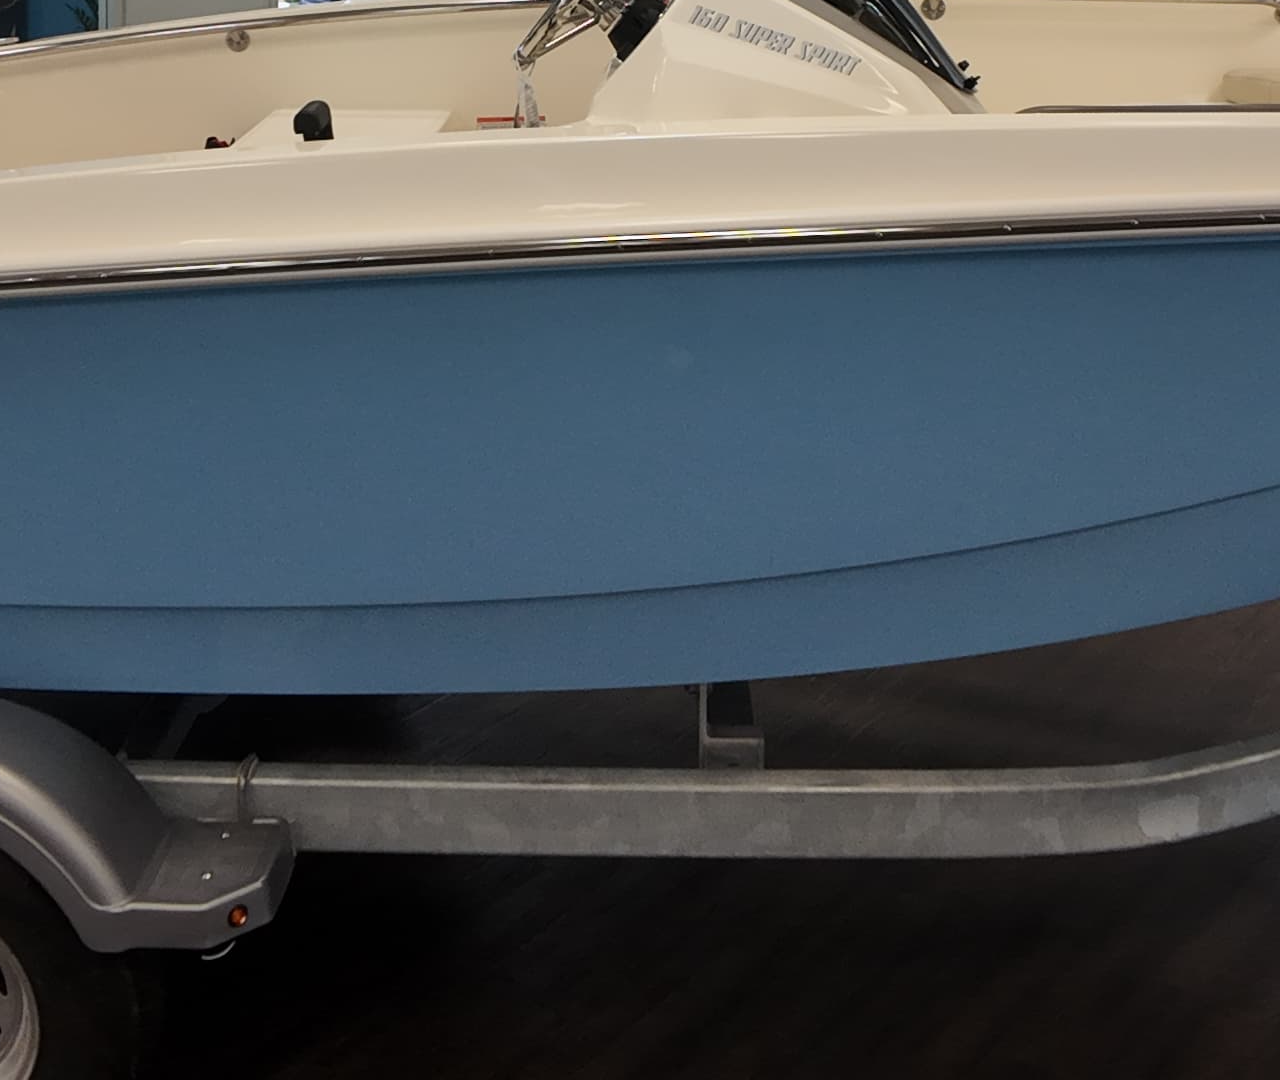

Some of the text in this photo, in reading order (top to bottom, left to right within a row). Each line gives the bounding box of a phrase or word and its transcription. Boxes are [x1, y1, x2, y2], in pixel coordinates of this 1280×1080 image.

[688, 5, 862, 77] 160 SUPER SPORT
